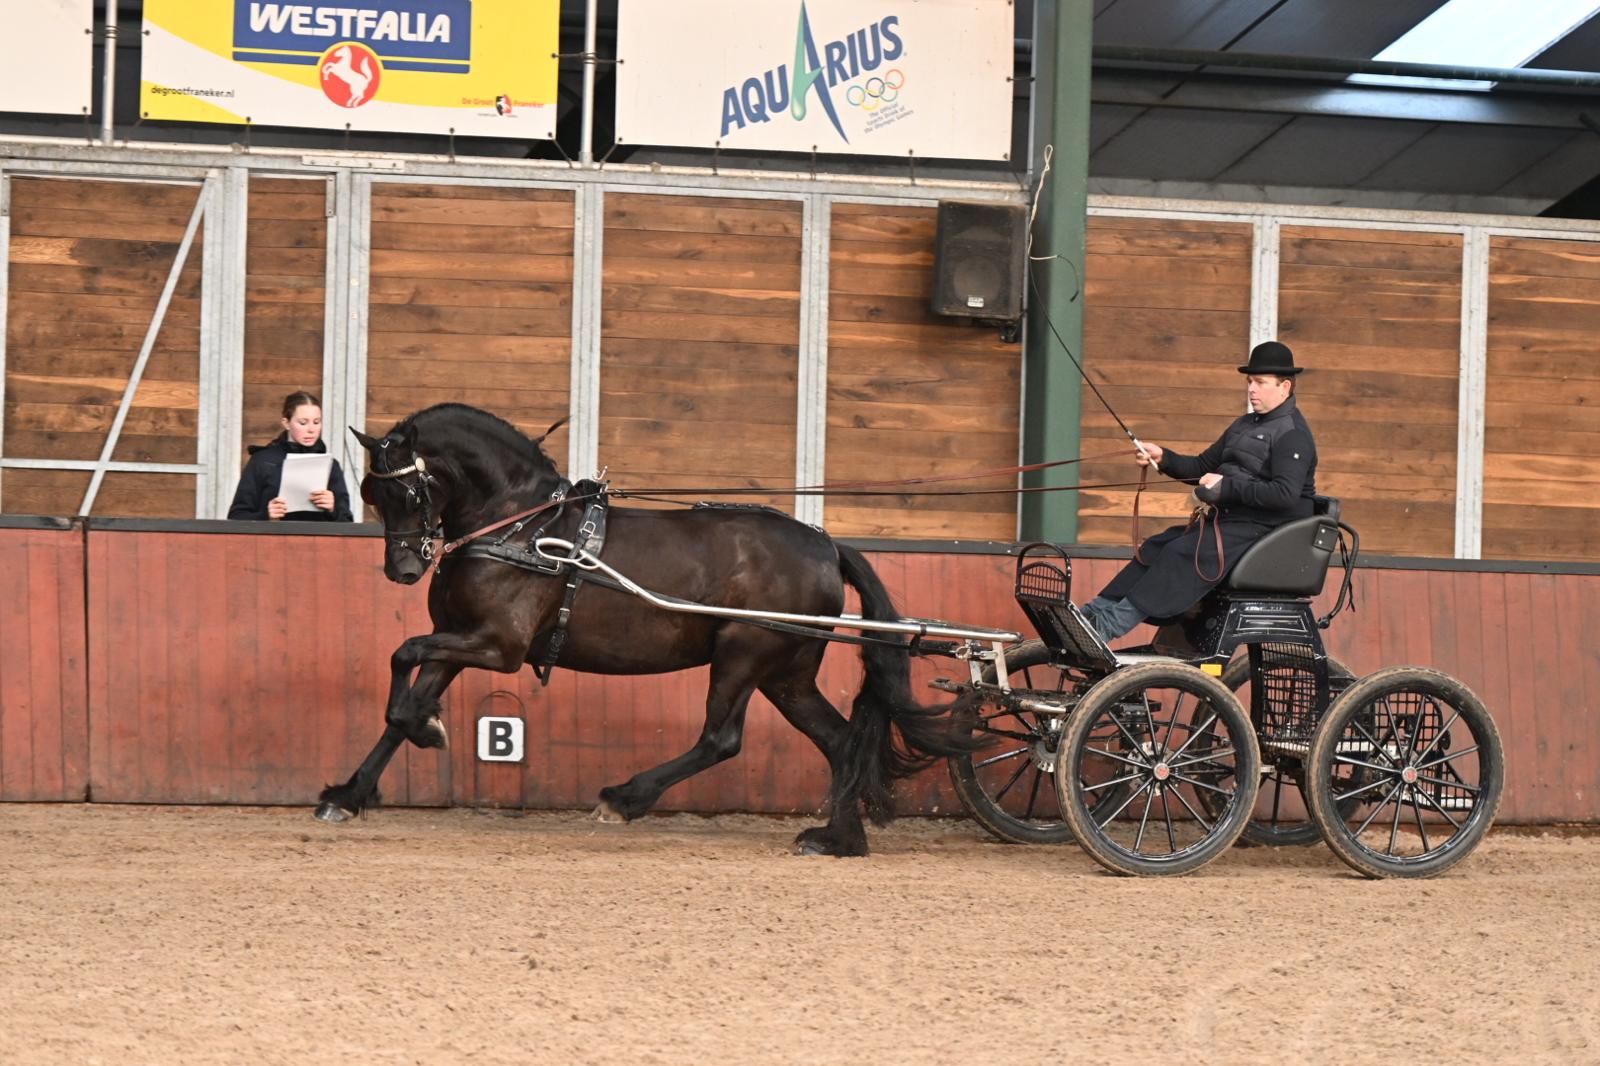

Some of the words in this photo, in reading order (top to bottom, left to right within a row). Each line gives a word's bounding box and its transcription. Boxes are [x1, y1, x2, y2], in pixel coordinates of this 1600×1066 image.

[250, 2, 451, 43] WESTFALIA
[720, 0, 903, 145] AQUARIUS
[151, 86, 234, 98] degrootfraneker.nl
[489, 721, 514, 757] B
